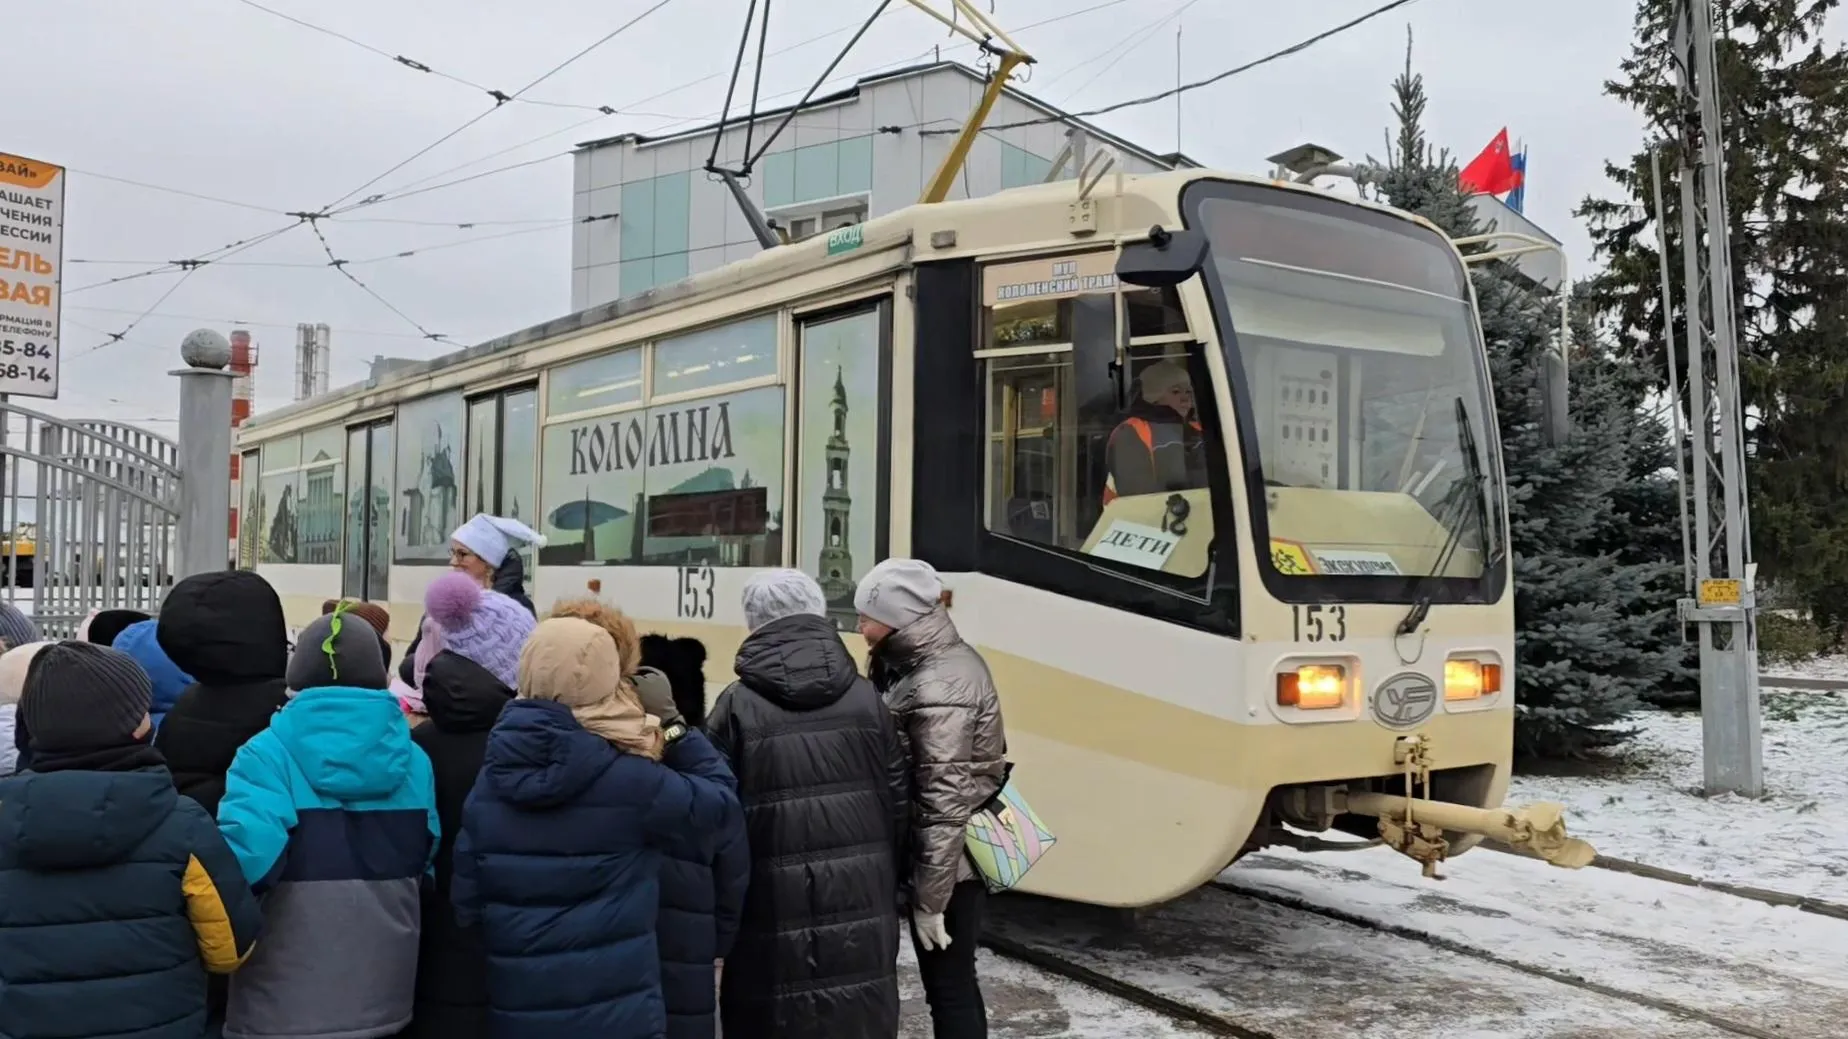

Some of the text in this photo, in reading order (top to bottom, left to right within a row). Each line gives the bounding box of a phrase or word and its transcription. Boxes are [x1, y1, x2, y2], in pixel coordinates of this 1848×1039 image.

[0, 207, 52, 227] ЧЕНИЯ
[0, 225, 52, 244] ЕССИИ
[829, 222, 862, 248] ВХОД
[0, 246, 53, 275] ЕЛЬ
[1053, 261, 1077, 277] МУП
[997, 275, 1080, 299] КОЛОМЕНСКИЙ
[0, 340, 51, 359] 5-84
[570, 402, 736, 475] КОЛОМНА
[1100, 529, 1172, 556] ДЕТИ
[677, 566, 716, 619] 153
[1292, 605, 1346, 642] 153
